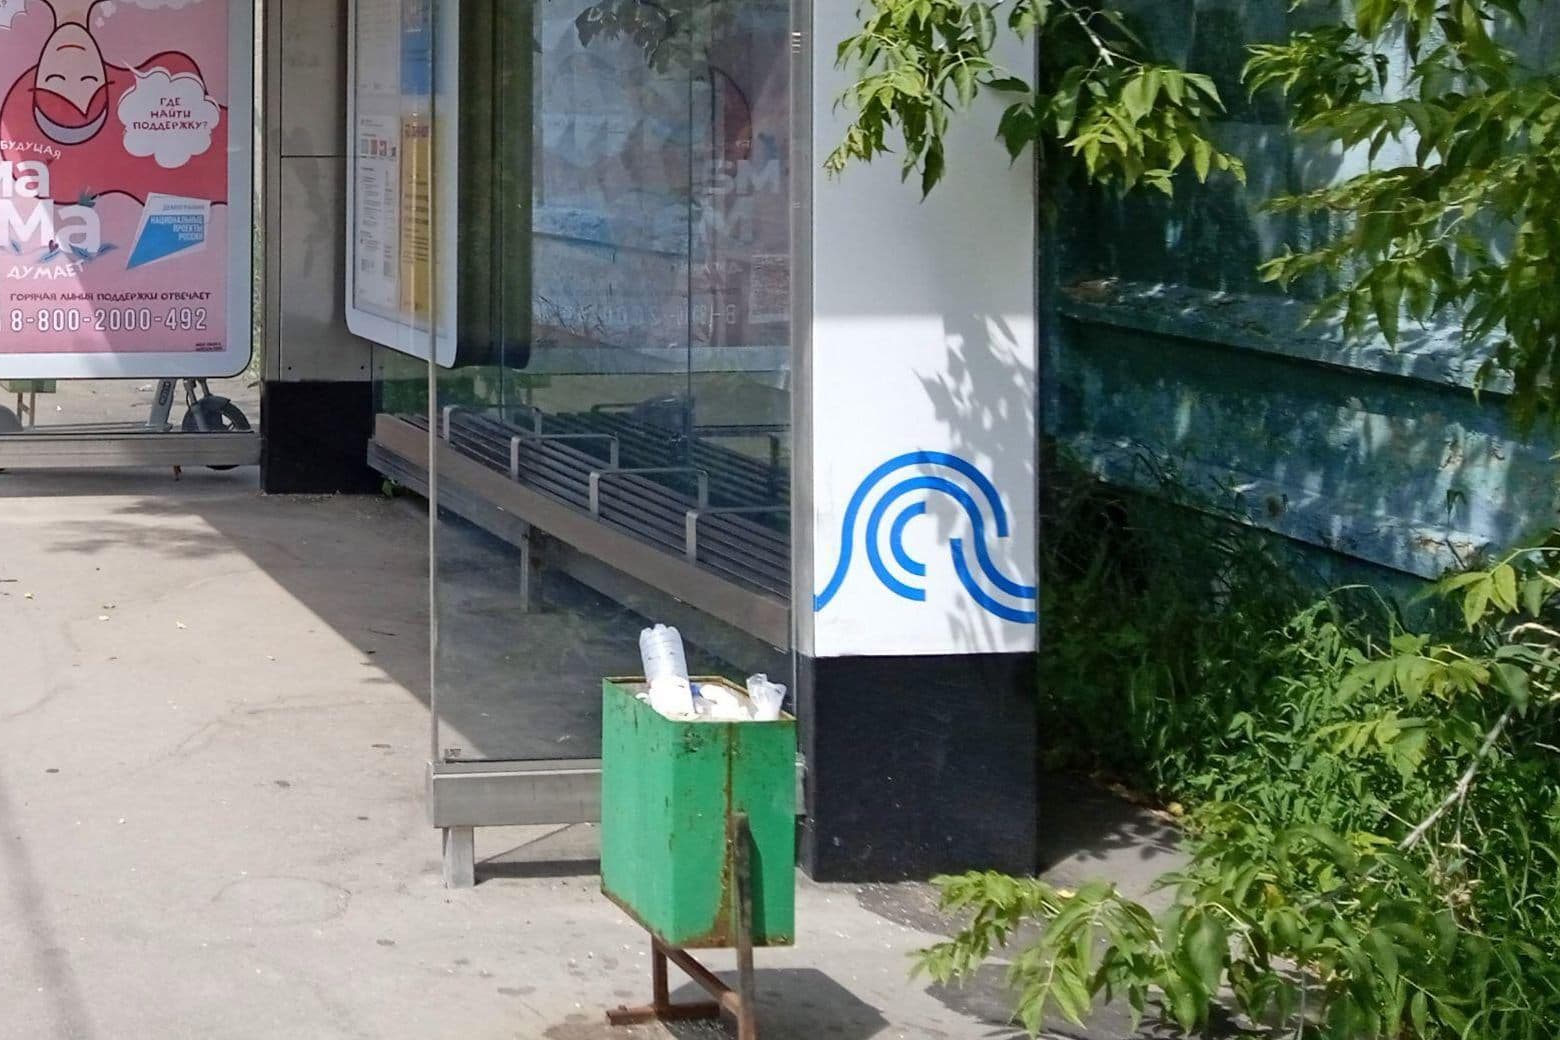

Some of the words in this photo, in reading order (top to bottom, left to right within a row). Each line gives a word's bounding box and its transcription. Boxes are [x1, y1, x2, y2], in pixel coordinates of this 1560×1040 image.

[159, 97, 182, 107] ГДЕ
[132, 120, 209, 131] ПОДДЕРЖКУ?
[0, 140, 62, 160] БУДУЩАЯ
[7, 262, 84, 280] ДУМАЕТ
[9, 292, 57, 301] ГОРЯЧАЯ
[60, 292, 94, 301] ЛИНИЯ
[96, 291, 158, 302] ПОДДЕРЖКИ
[160, 291, 212, 301] ОТВЕЧАЕТ
[10, 307, 208, 332] 8-800-2000-492
